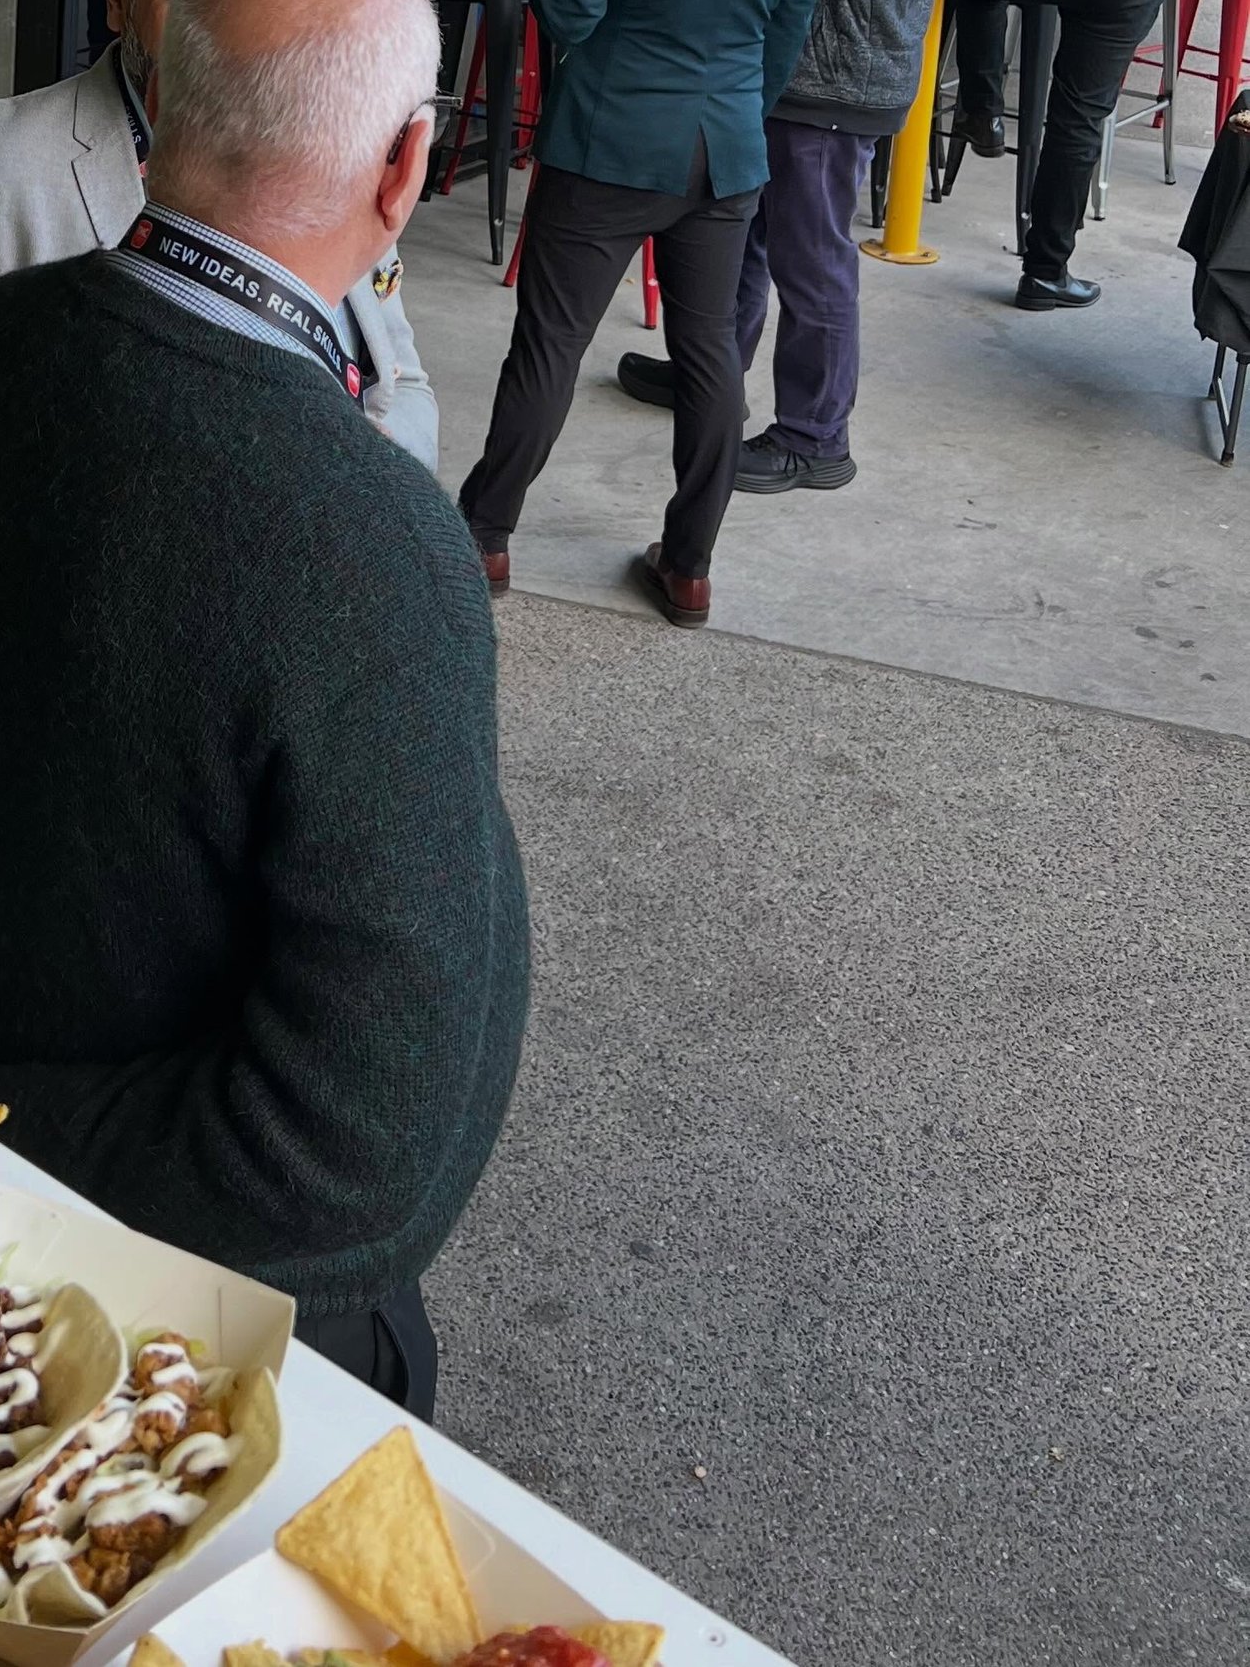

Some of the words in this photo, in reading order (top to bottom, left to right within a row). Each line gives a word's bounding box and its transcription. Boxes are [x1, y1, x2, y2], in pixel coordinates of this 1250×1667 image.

[158, 235, 201, 266] NEW
[200, 255, 263, 303] IDEAS.
[266, 292, 311, 335] REAL
[312, 324, 343, 373] SKILLS.
